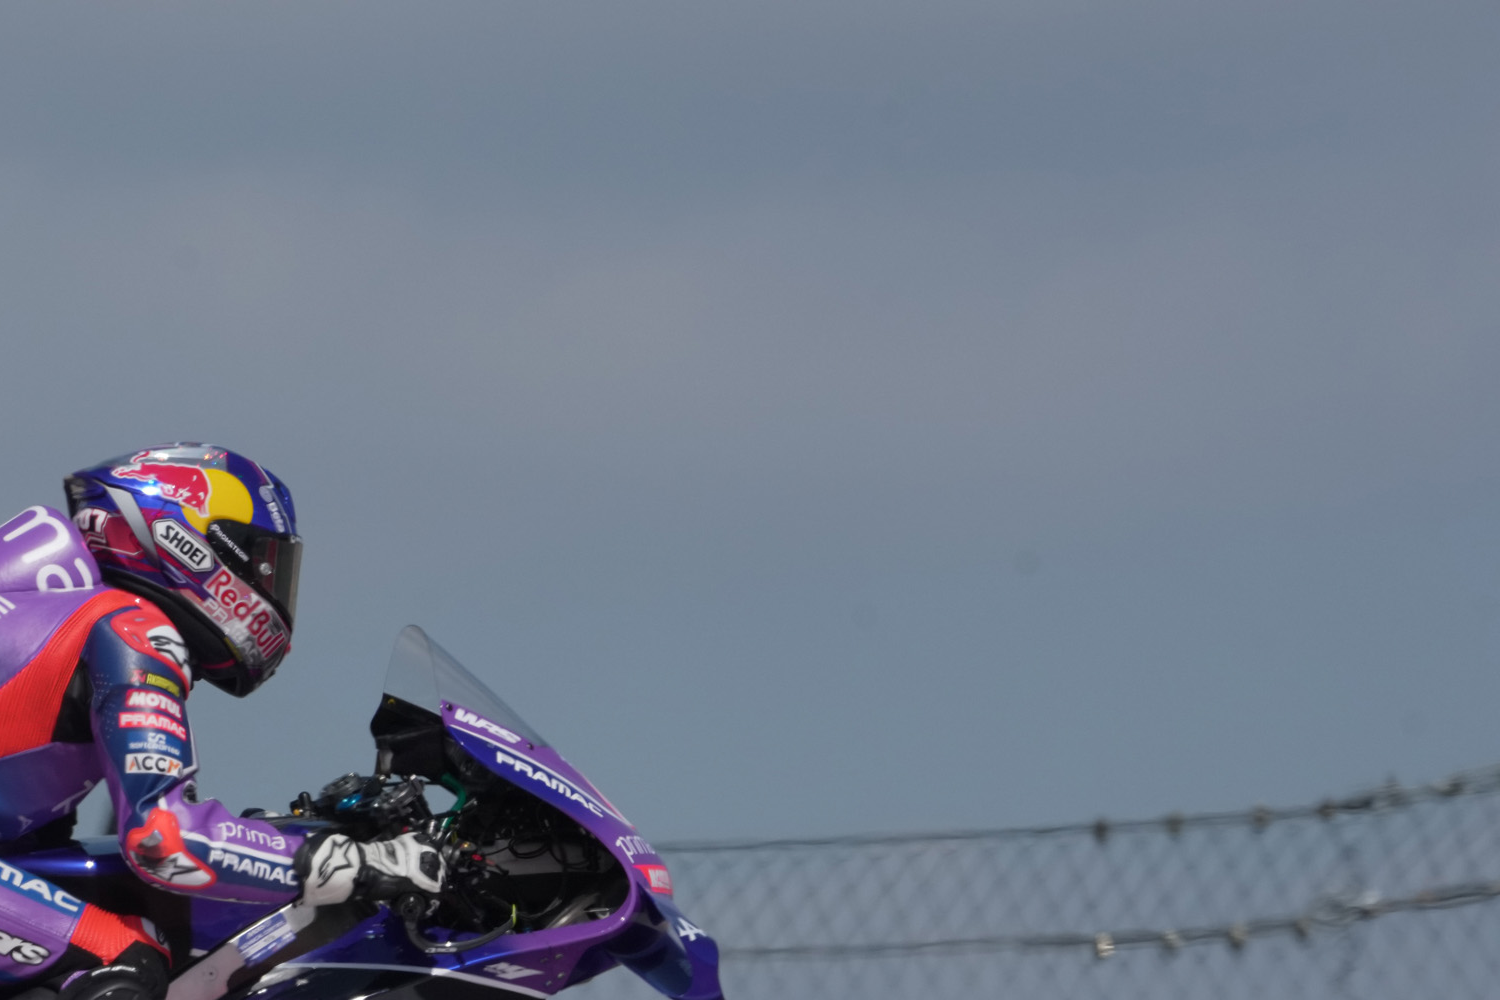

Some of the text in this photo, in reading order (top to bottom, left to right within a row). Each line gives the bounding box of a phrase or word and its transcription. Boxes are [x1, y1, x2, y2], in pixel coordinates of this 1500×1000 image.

[160, 524, 208, 566] SHOEI
[127, 691, 181, 719] MOTUL
[120, 713, 186, 739] PRAMAC
[496, 751, 603, 818] PRAMAC
[218, 821, 287, 851] prima
[209, 849, 299, 886] PRAMAC
